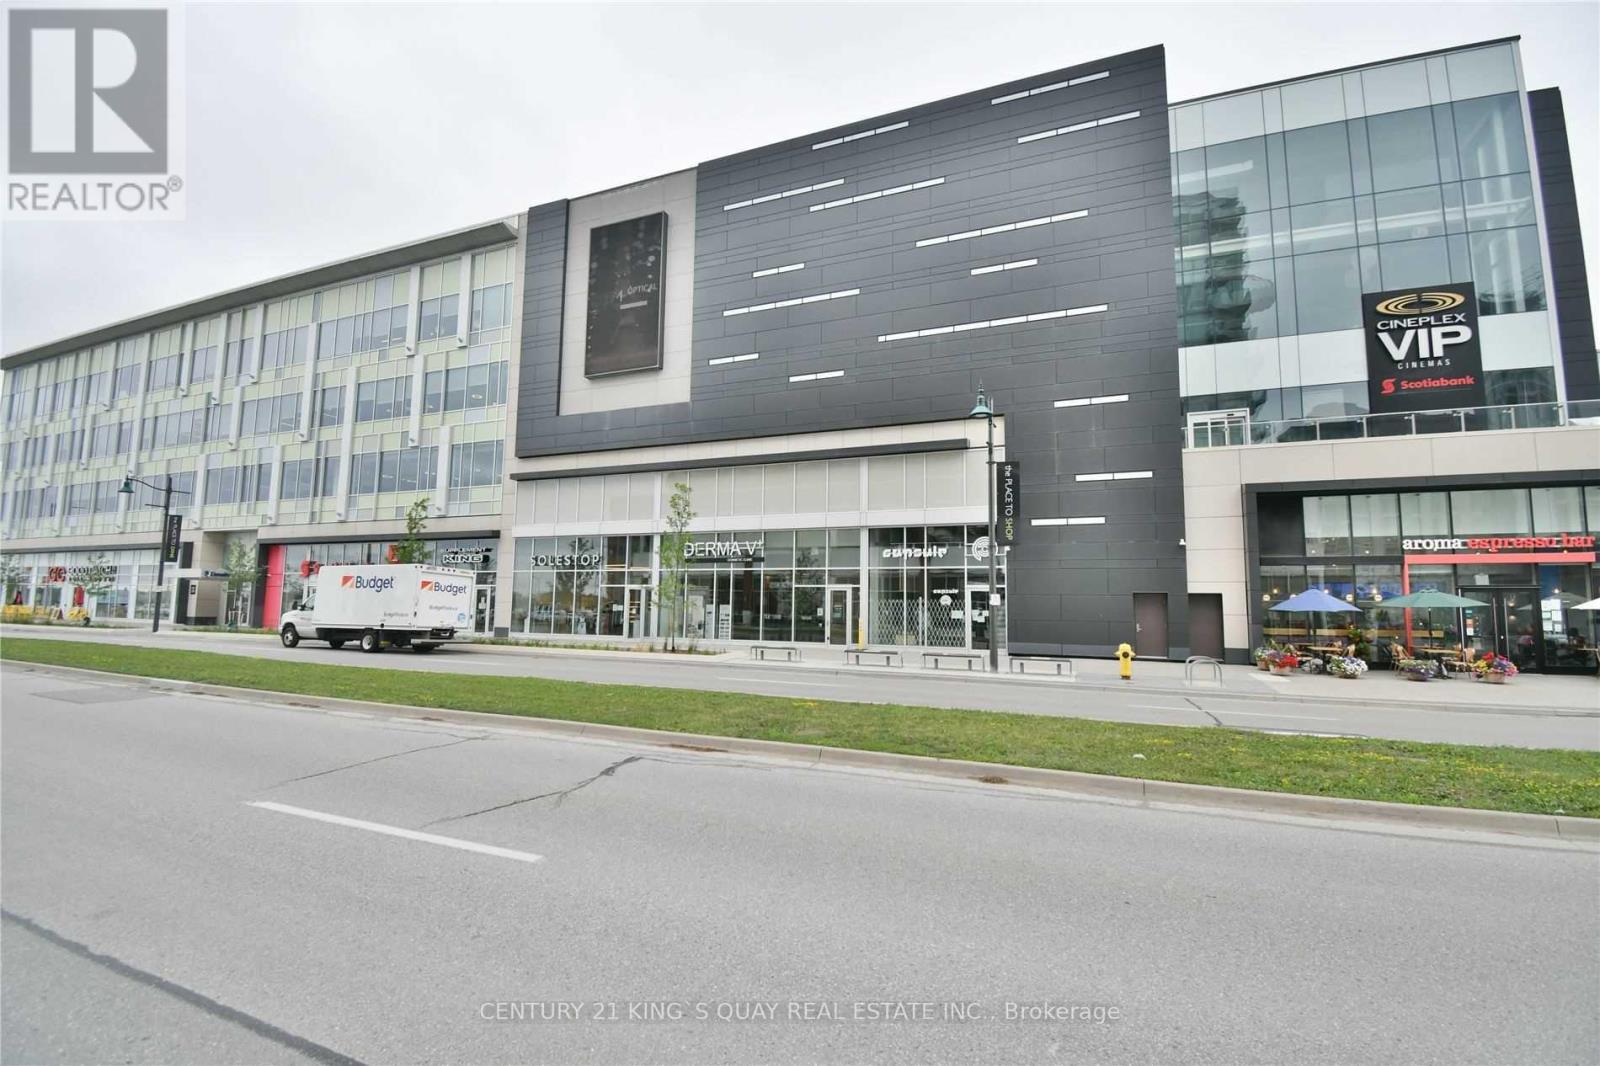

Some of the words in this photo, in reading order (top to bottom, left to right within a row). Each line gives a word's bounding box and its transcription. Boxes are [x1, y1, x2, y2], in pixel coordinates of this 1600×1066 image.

[1377, 312, 1466, 330] CINEPLEX
[1377, 324, 1473, 361] VIP
[1397, 358, 1451, 370] CINEMAS
[1401, 376, 1475, 390] Scotiabank
[1005, 464, 1013, 477] the
[1005, 478, 1013, 503] PLACE
[1005, 504, 1013, 517] TO
[1005, 518, 1014, 540] SHOP
[683, 541, 742, 557] DERMA
[1402, 538, 1462, 551] aroma
[1467, 537, 1556, 553] espresso
[1561, 533, 1596, 547] bar
[530, 554, 600, 566] SOLESTOP
[355, 575, 394, 592] Budget
[433, 581, 467, 596] Budget
